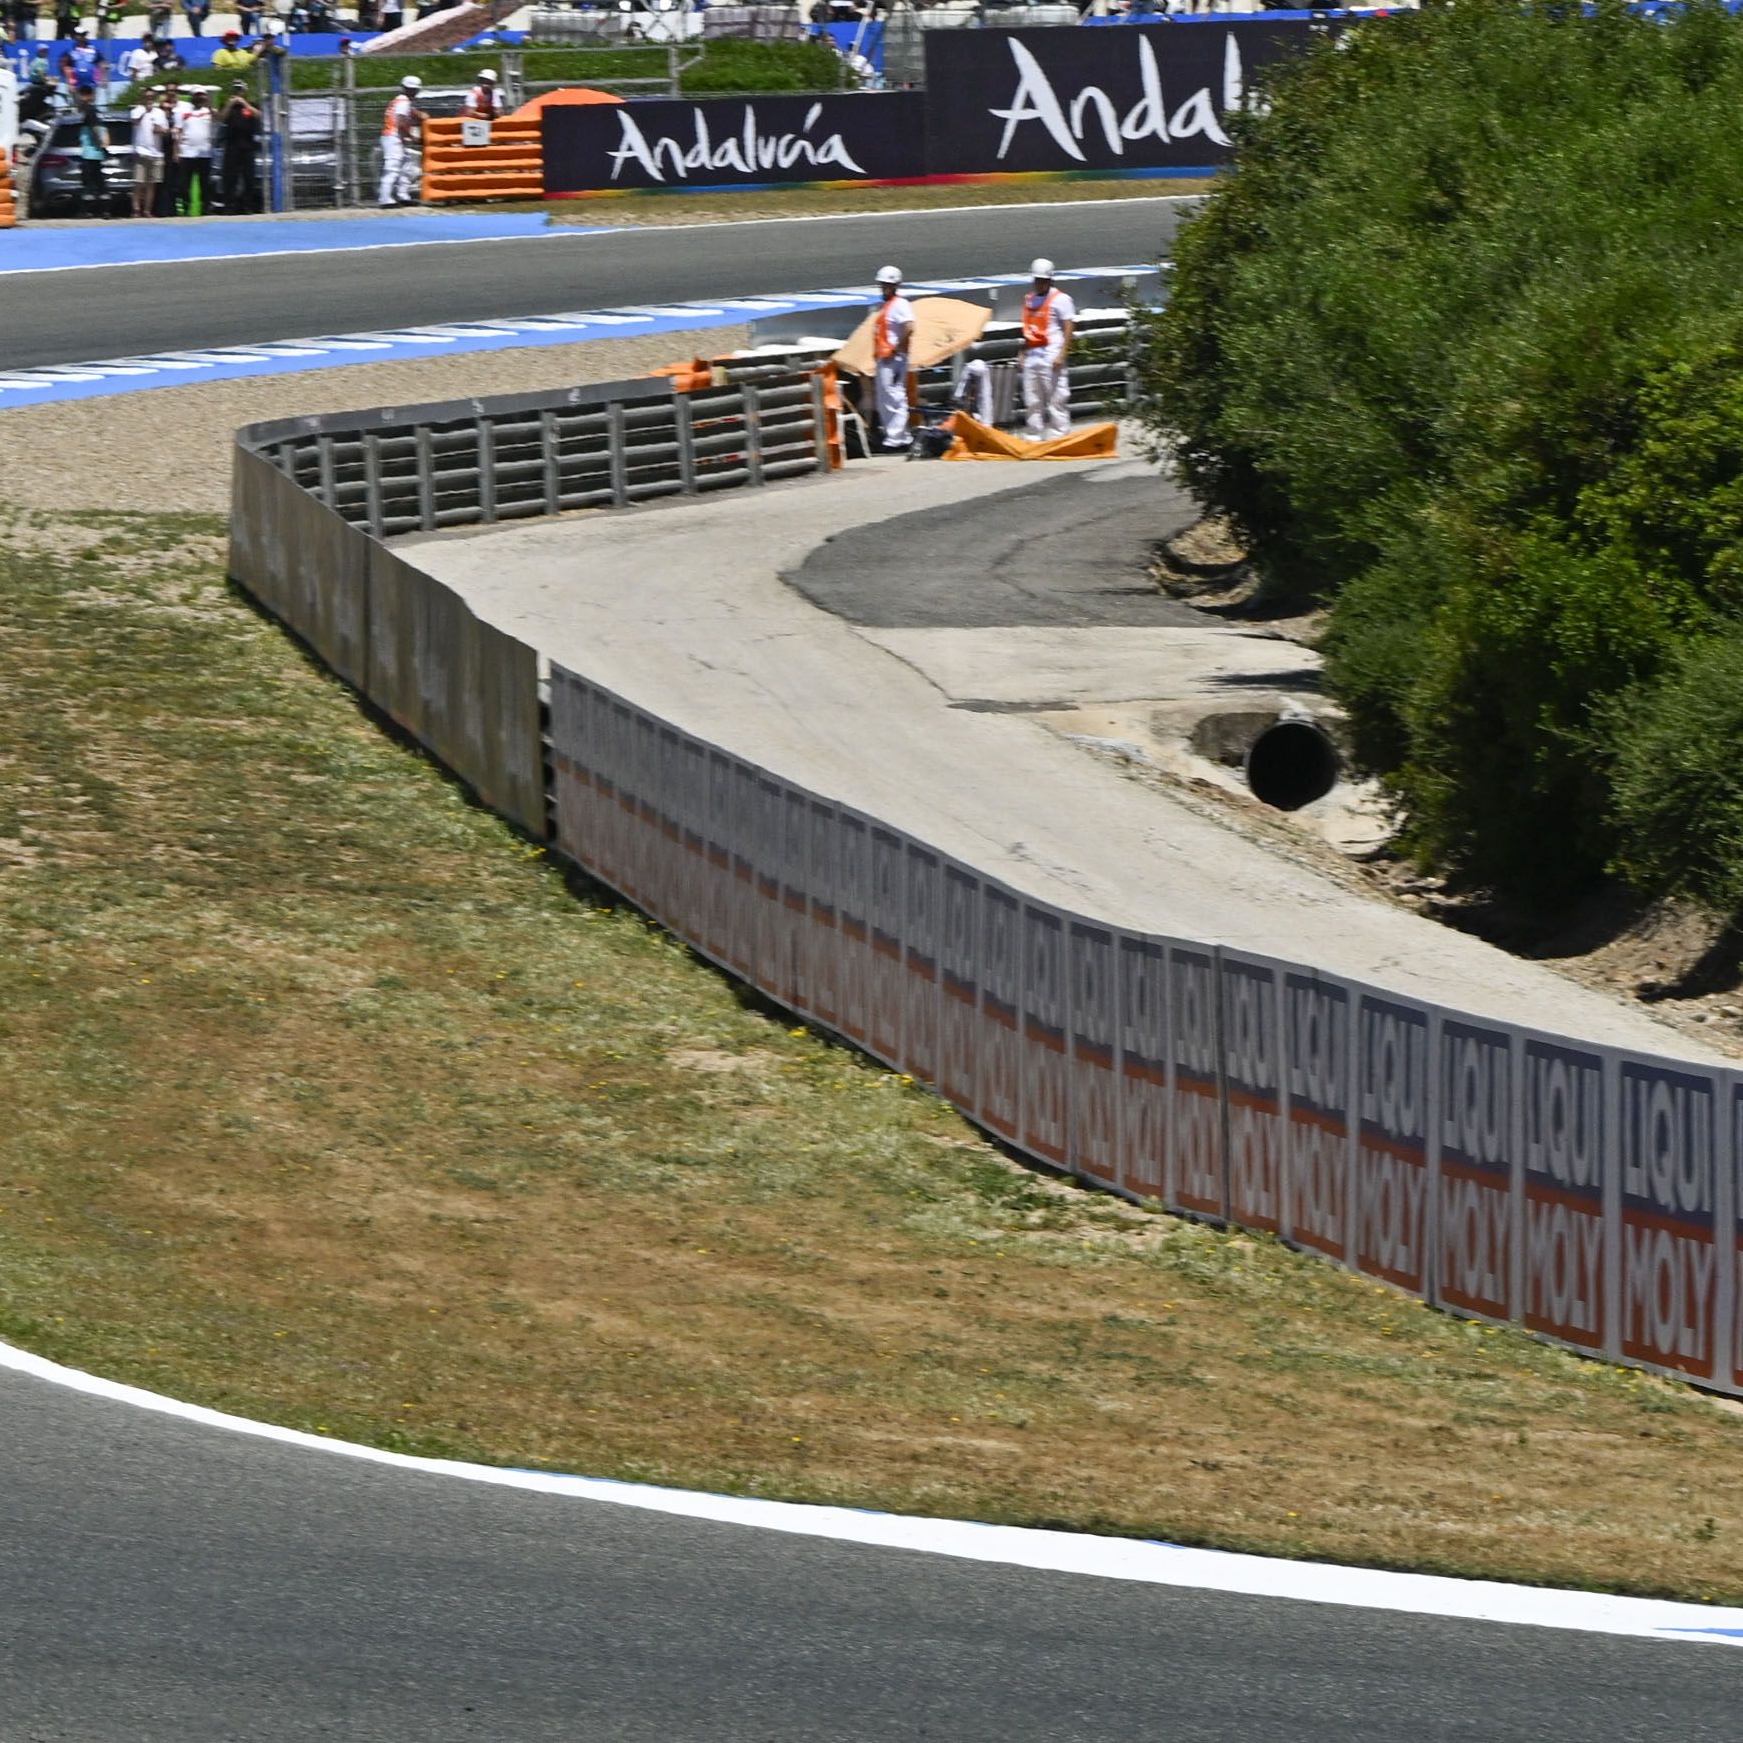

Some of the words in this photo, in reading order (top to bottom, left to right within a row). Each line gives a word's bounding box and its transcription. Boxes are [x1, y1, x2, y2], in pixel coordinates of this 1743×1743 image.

[606, 103, 867, 182] Andalucía
[1363, 1007, 1426, 1140] LIQUI
[1443, 1033, 1509, 1164] LIQUI
[1526, 1054, 1602, 1189] LIQUI
[1362, 1145, 1426, 1276] MOLY
[1625, 1075, 1712, 1213] LIQUI
[1443, 1173, 1510, 1306] MOLY
[1526, 1196, 1603, 1334] MOLY
[1625, 1222, 1714, 1361] MOLY
